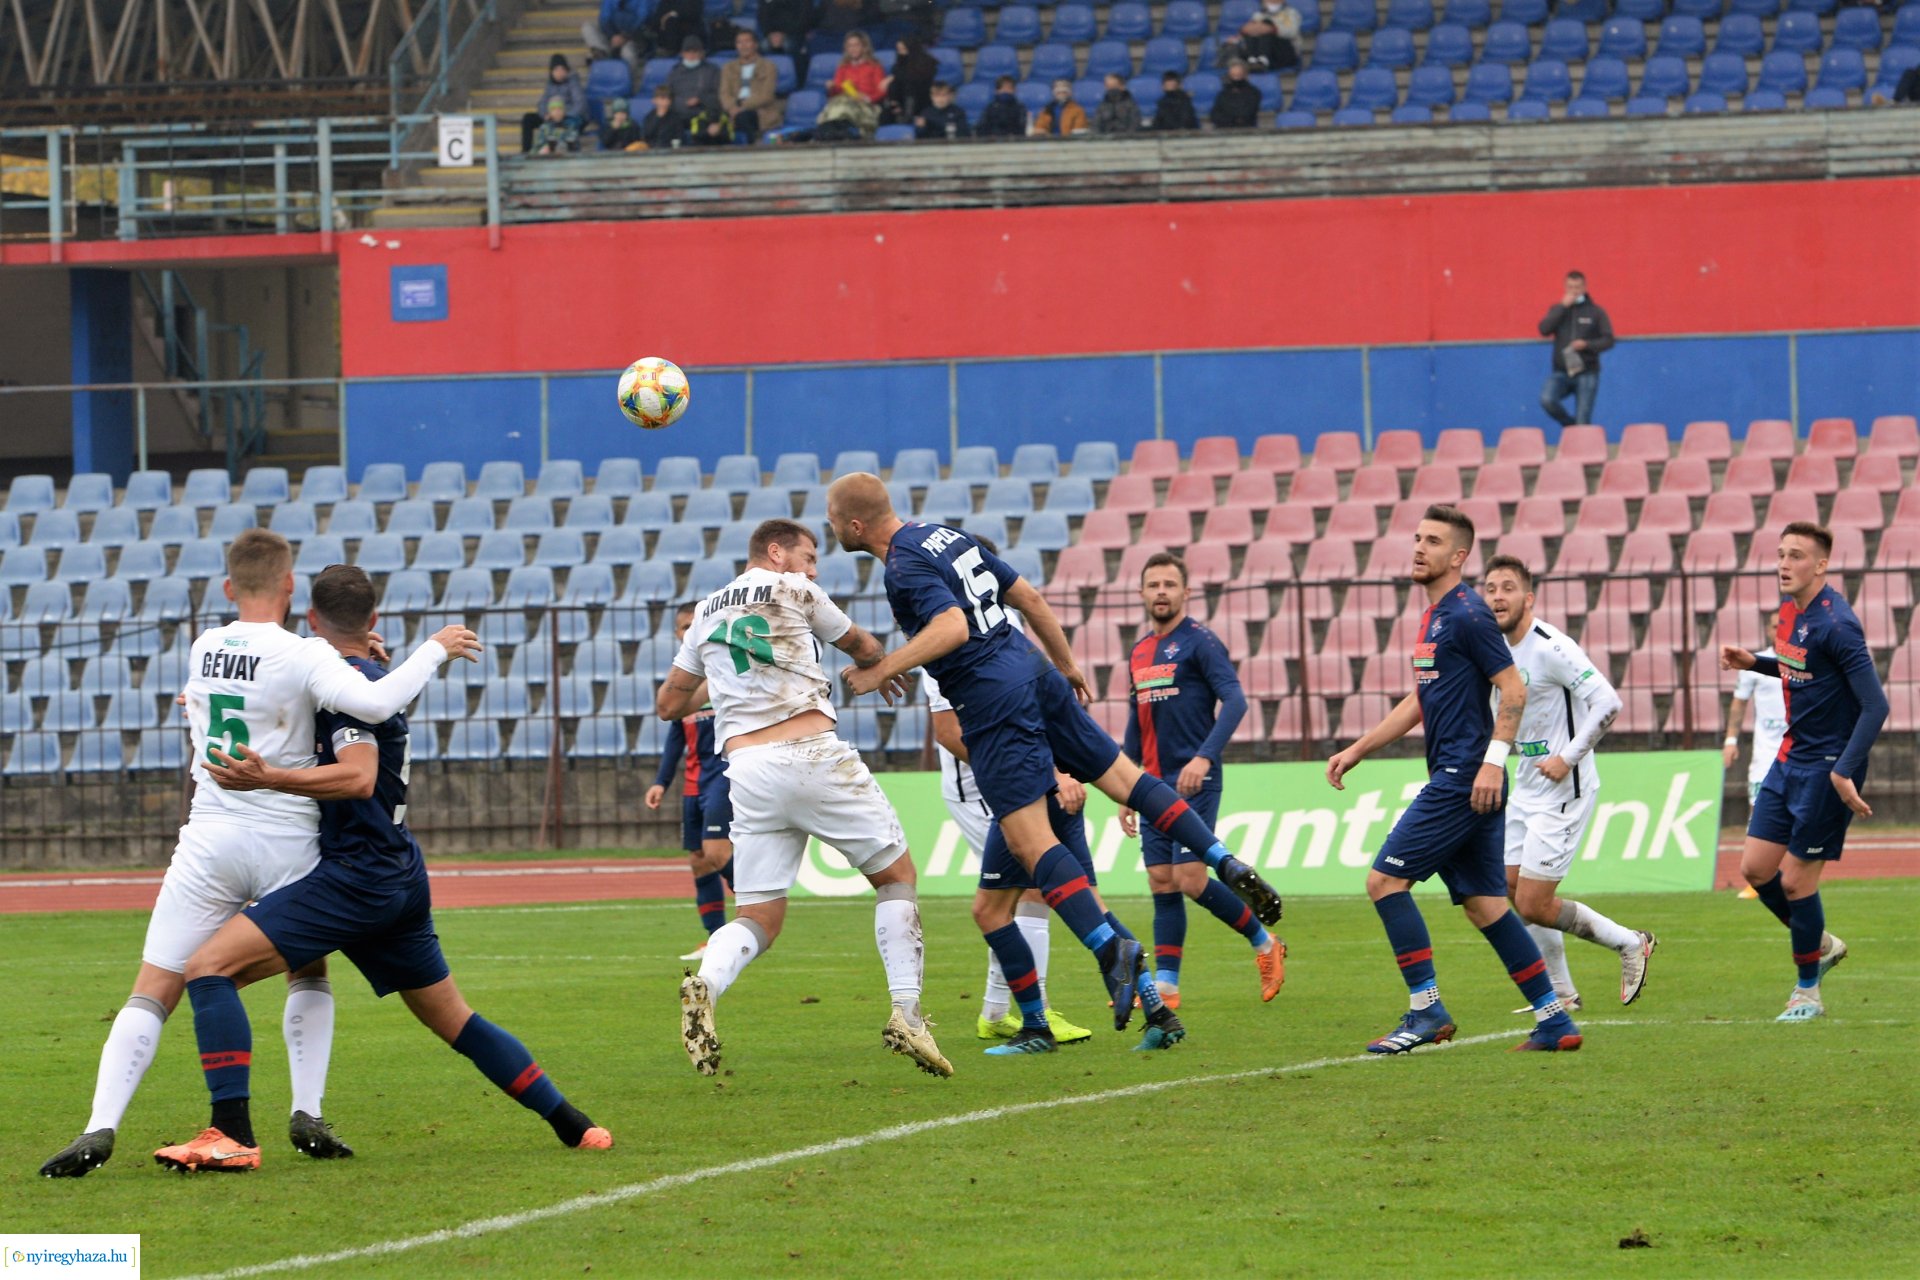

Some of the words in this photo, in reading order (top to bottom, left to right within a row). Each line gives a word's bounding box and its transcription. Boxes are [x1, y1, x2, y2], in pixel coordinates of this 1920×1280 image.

[447, 137, 464, 161] C
[951, 545, 1006, 634] 15
[202, 648, 261, 682] GÉVAY
[206, 693, 250, 768] 5
[343, 728, 361, 743] C
[1385, 855, 1405, 867] JAKO
